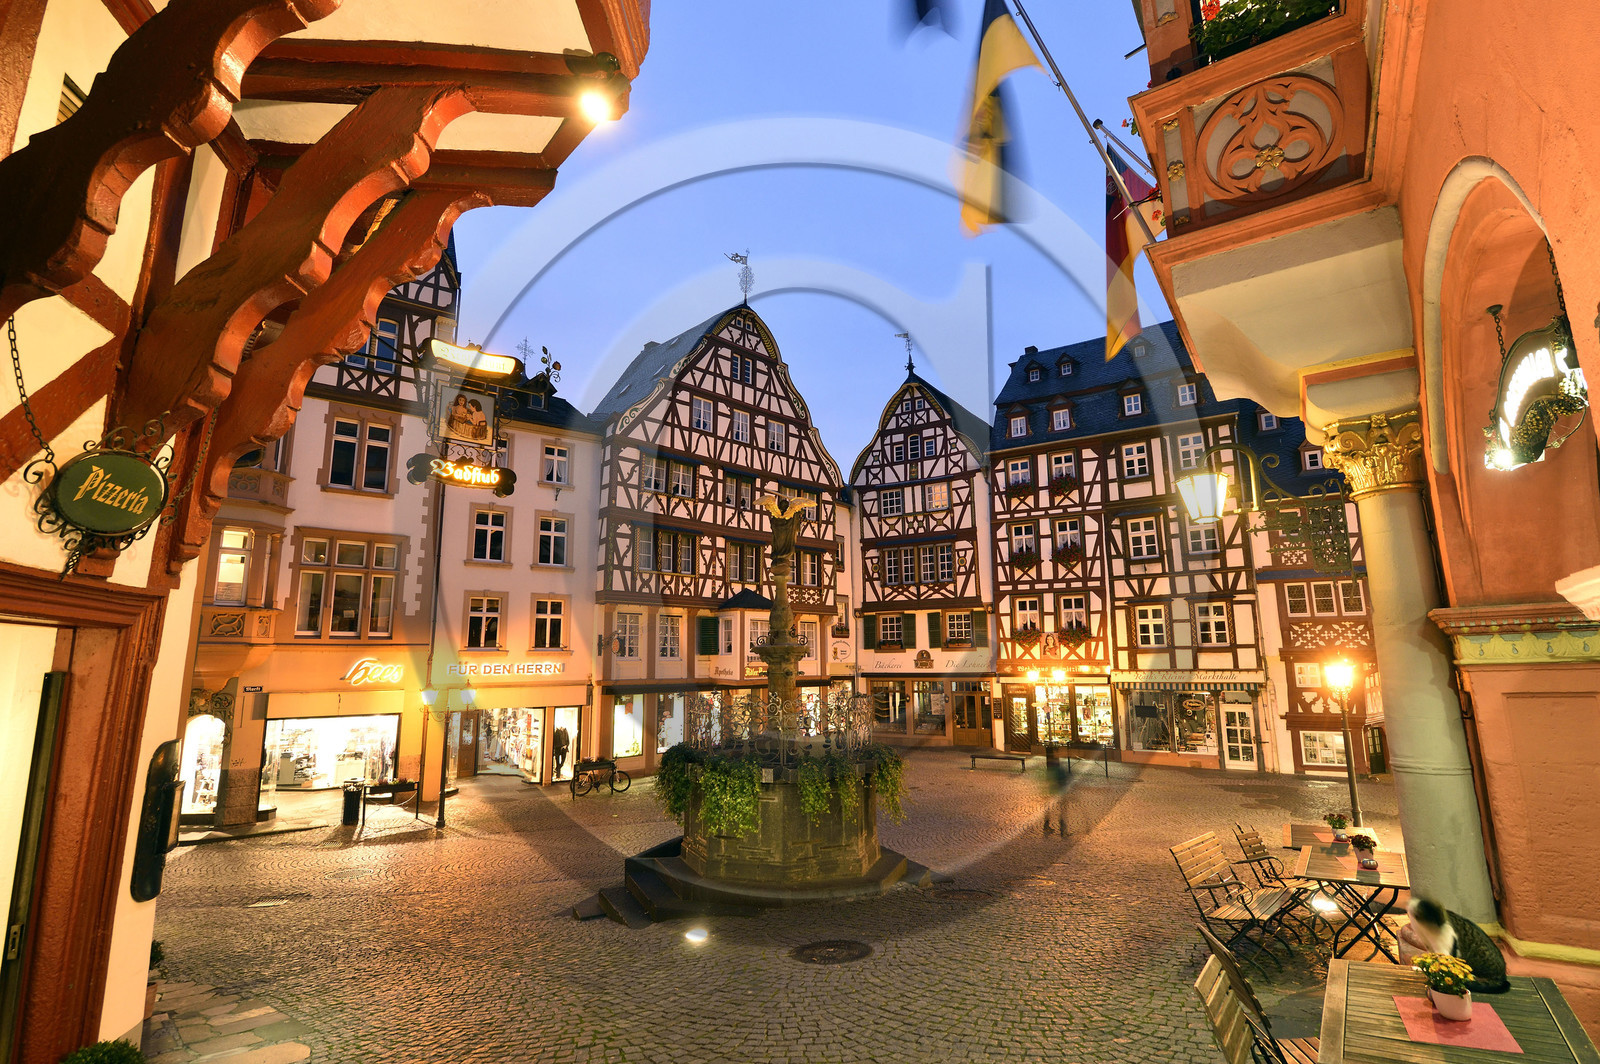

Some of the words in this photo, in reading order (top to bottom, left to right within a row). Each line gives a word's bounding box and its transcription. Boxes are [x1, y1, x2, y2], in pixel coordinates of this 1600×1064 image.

[73, 465, 149, 515] Pizzeria
[448, 661, 479, 675] FÜR
[482, 663, 512, 675] DEN
[515, 662, 564, 675] HERRN
[1192, 672, 1239, 681] Markthalle
